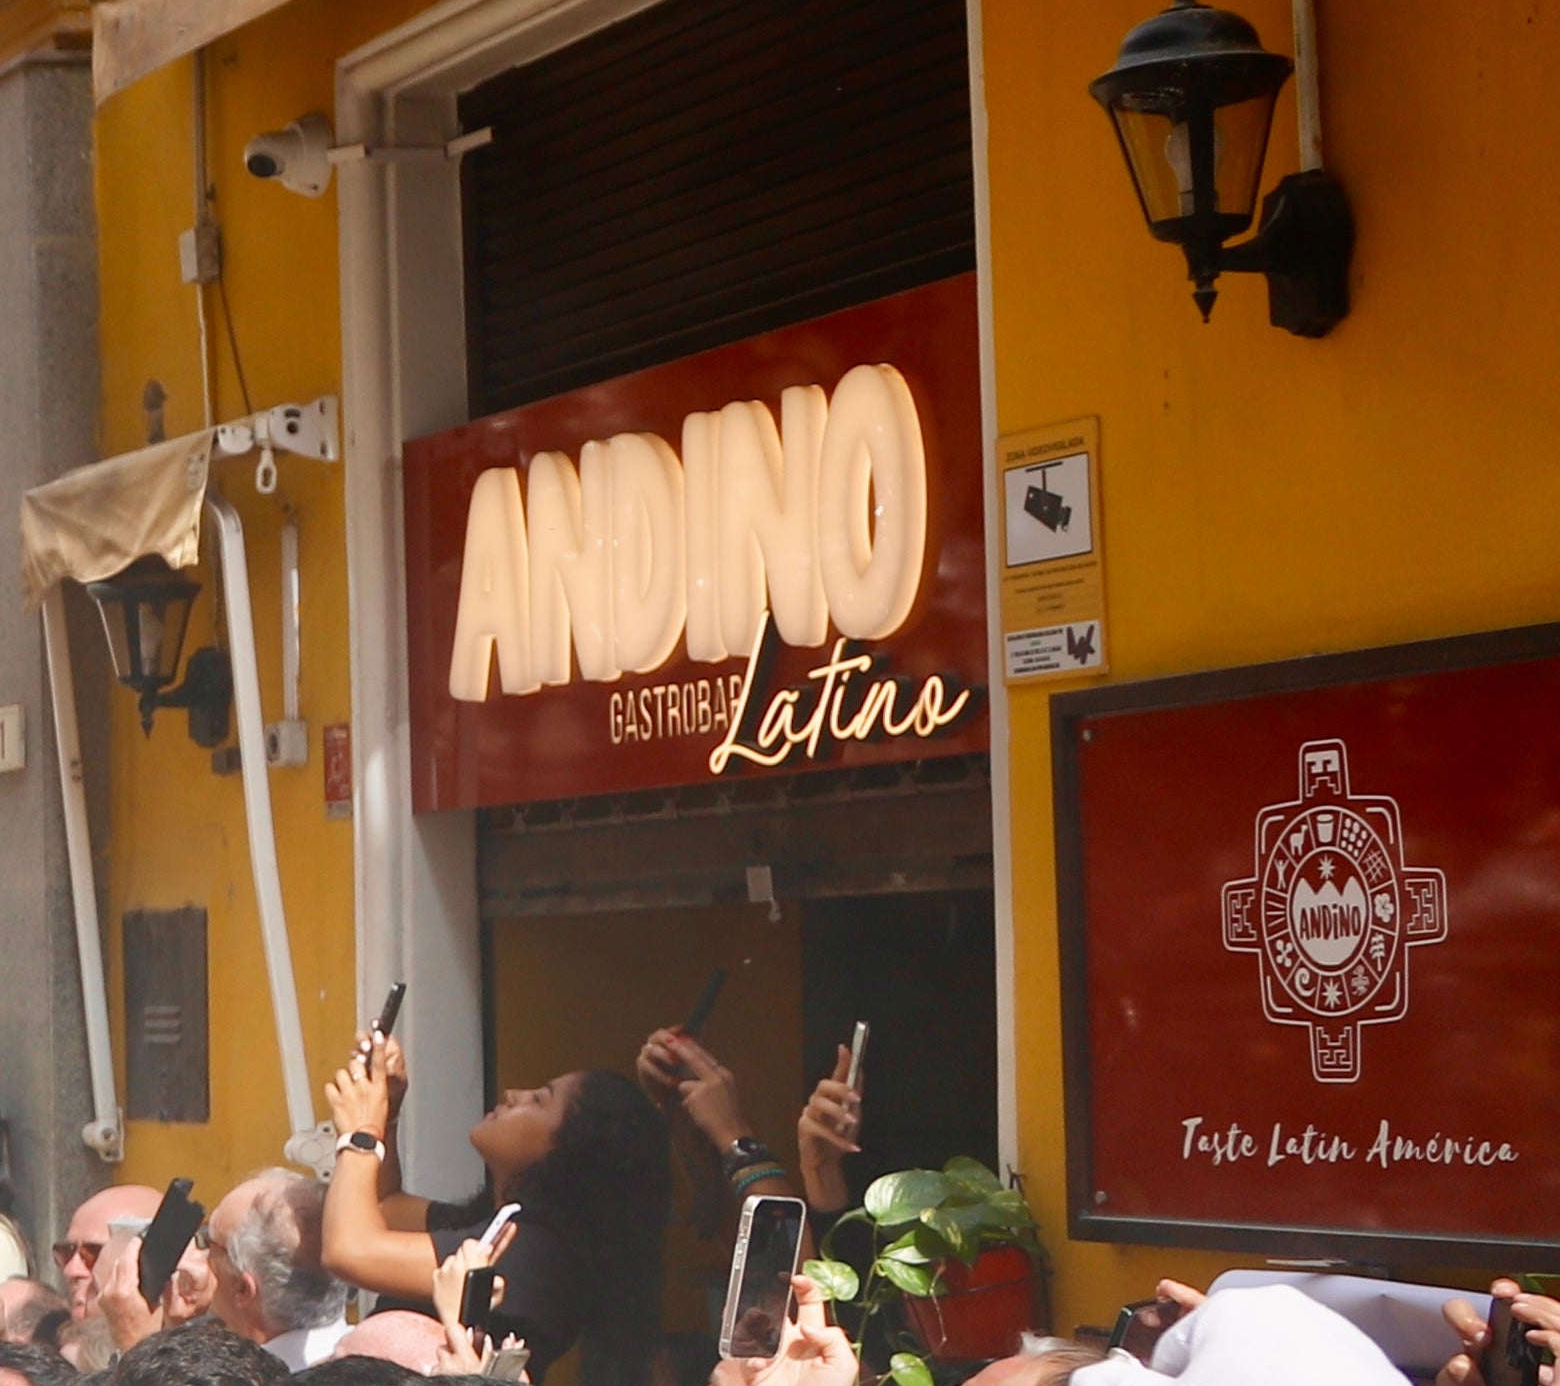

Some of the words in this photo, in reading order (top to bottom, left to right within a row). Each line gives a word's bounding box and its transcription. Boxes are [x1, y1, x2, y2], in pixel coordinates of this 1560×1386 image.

[449, 363, 928, 702] ANDINO
[709, 609, 970, 775] Latino
[1182, 1116, 1259, 1166] Taste
[1267, 1122, 1357, 1167] Latin
[1365, 1119, 1519, 1169] América
